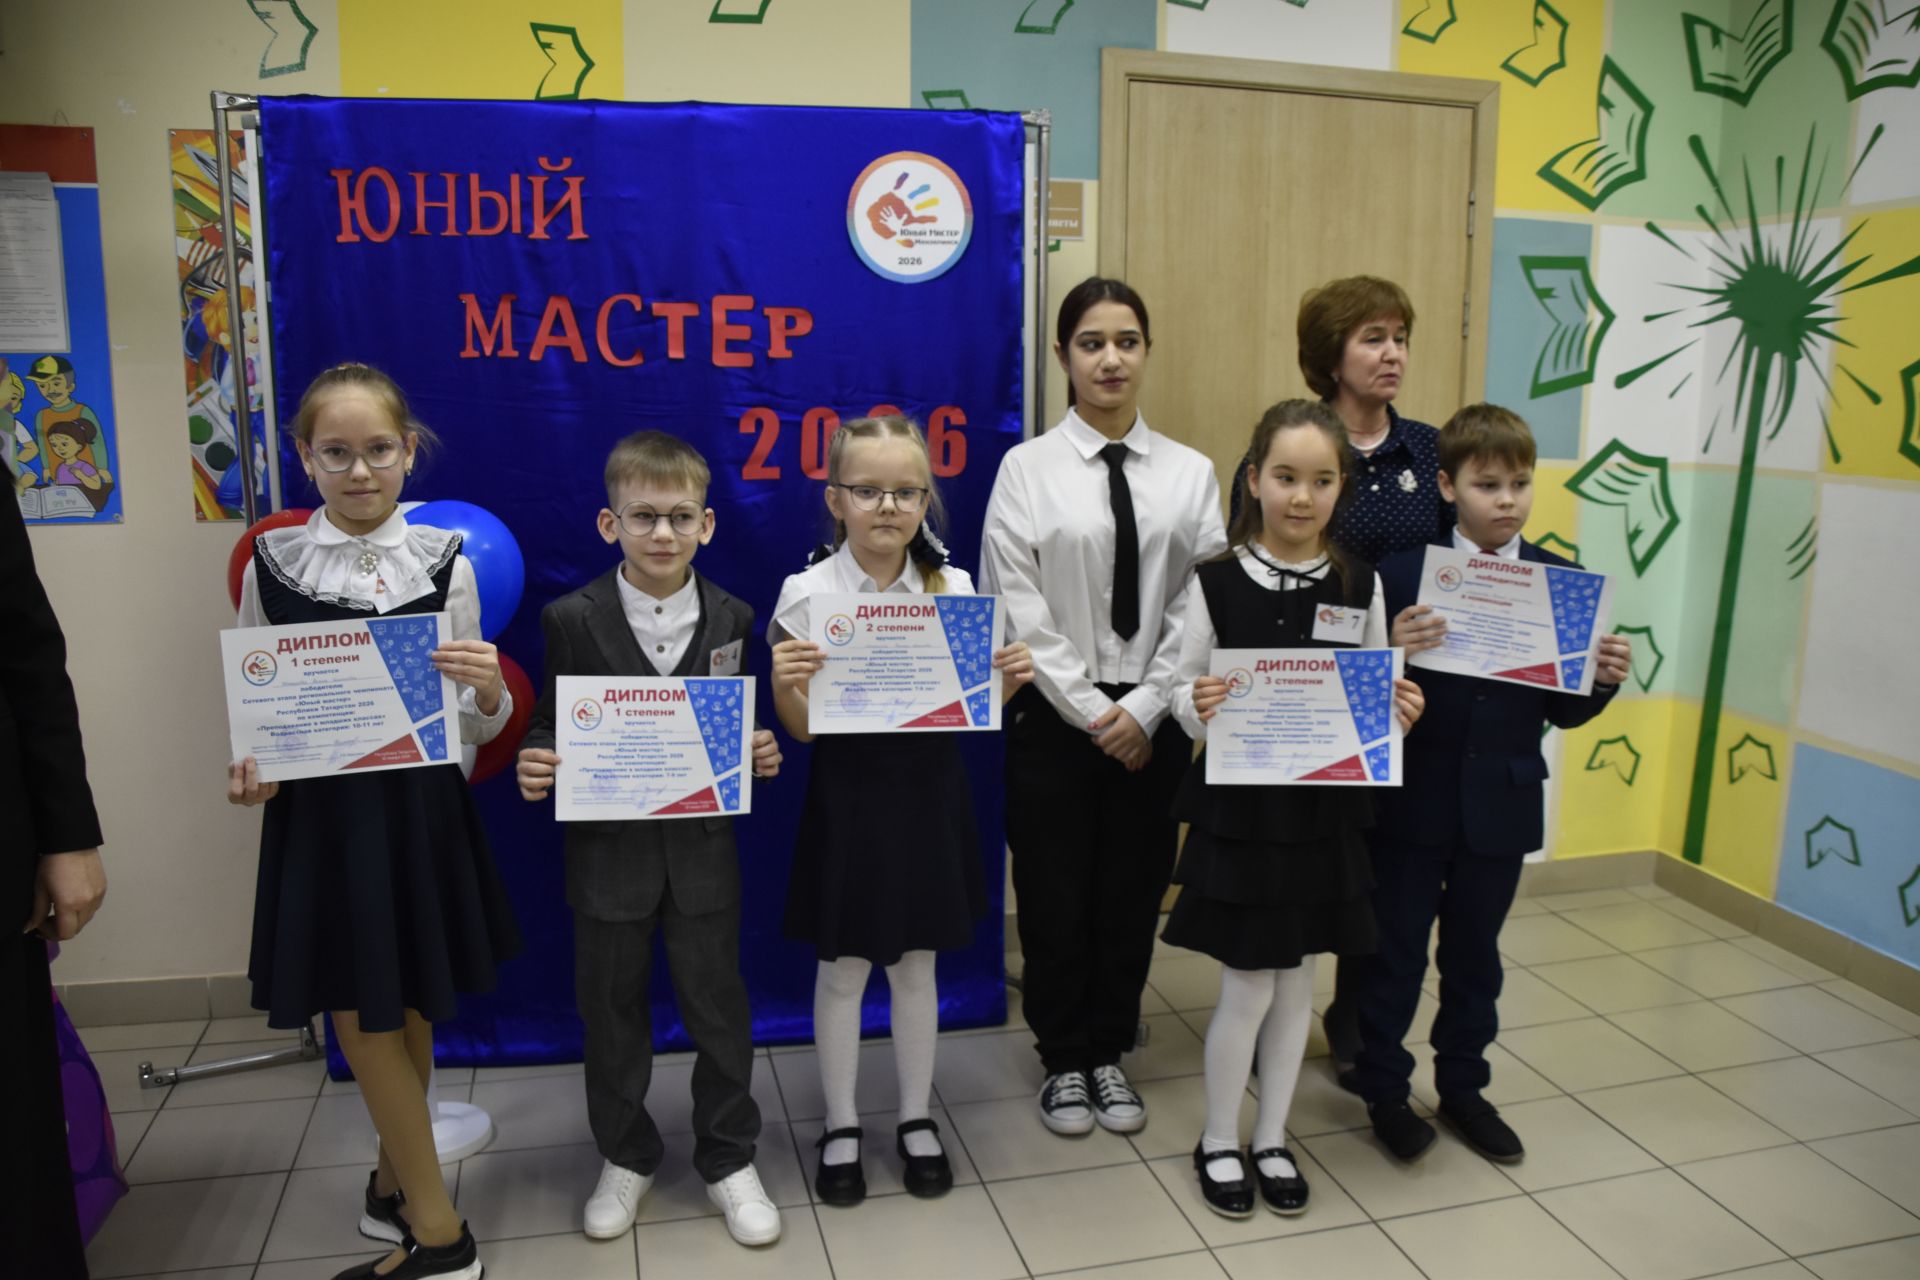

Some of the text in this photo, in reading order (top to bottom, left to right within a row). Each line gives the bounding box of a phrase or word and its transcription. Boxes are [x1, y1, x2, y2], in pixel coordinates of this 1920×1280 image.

[330, 156, 589, 244] ЮНЫЙ
[898, 257, 922, 265] 2026
[459, 293, 814, 368] МАСТЕР
[739, 404, 968, 481] 206
[1467, 557, 1532, 577] ДИПЛОМ
[855, 604, 935, 619] ДИПЛОМ
[866, 623, 873, 631] 2
[1351, 615, 1361, 630] 7
[277, 632, 369, 653] ДИПЛОМ
[291, 654, 359, 667] 1 степени
[1254, 659, 1335, 673] ДИПЛОМ
[1264, 676, 1271, 684] 3
[603, 688, 686, 703] ДИПЛОМ
[615, 707, 620, 716] 1
